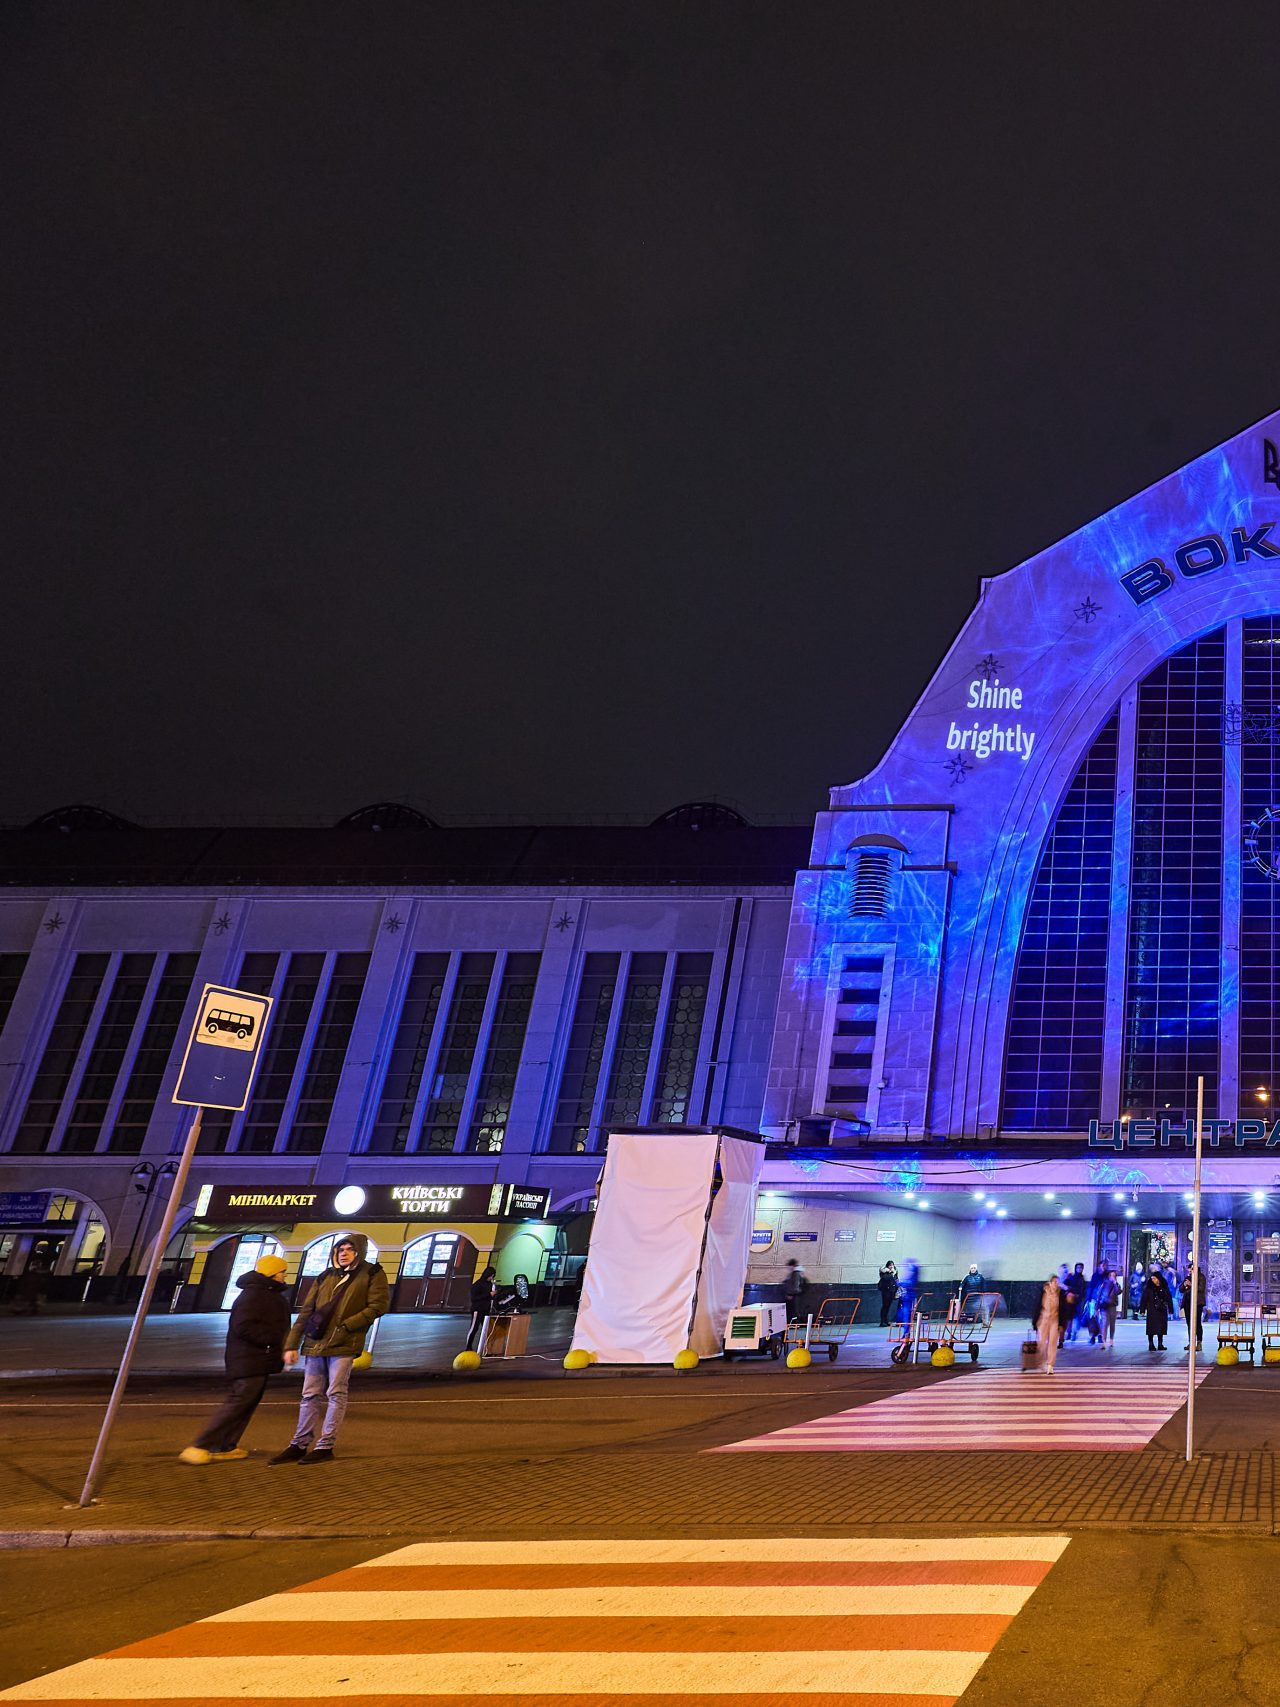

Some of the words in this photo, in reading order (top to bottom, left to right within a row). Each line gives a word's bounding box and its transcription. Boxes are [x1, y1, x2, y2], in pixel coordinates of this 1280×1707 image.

[966, 678, 1022, 709] Shine
[946, 721, 1035, 760] brightly
[228, 1194, 316, 1206] МІНІМАРКЕТ
[391, 1185, 464, 1200] КИЇВСЬКІ
[400, 1200, 450, 1213] ТОРТИ
